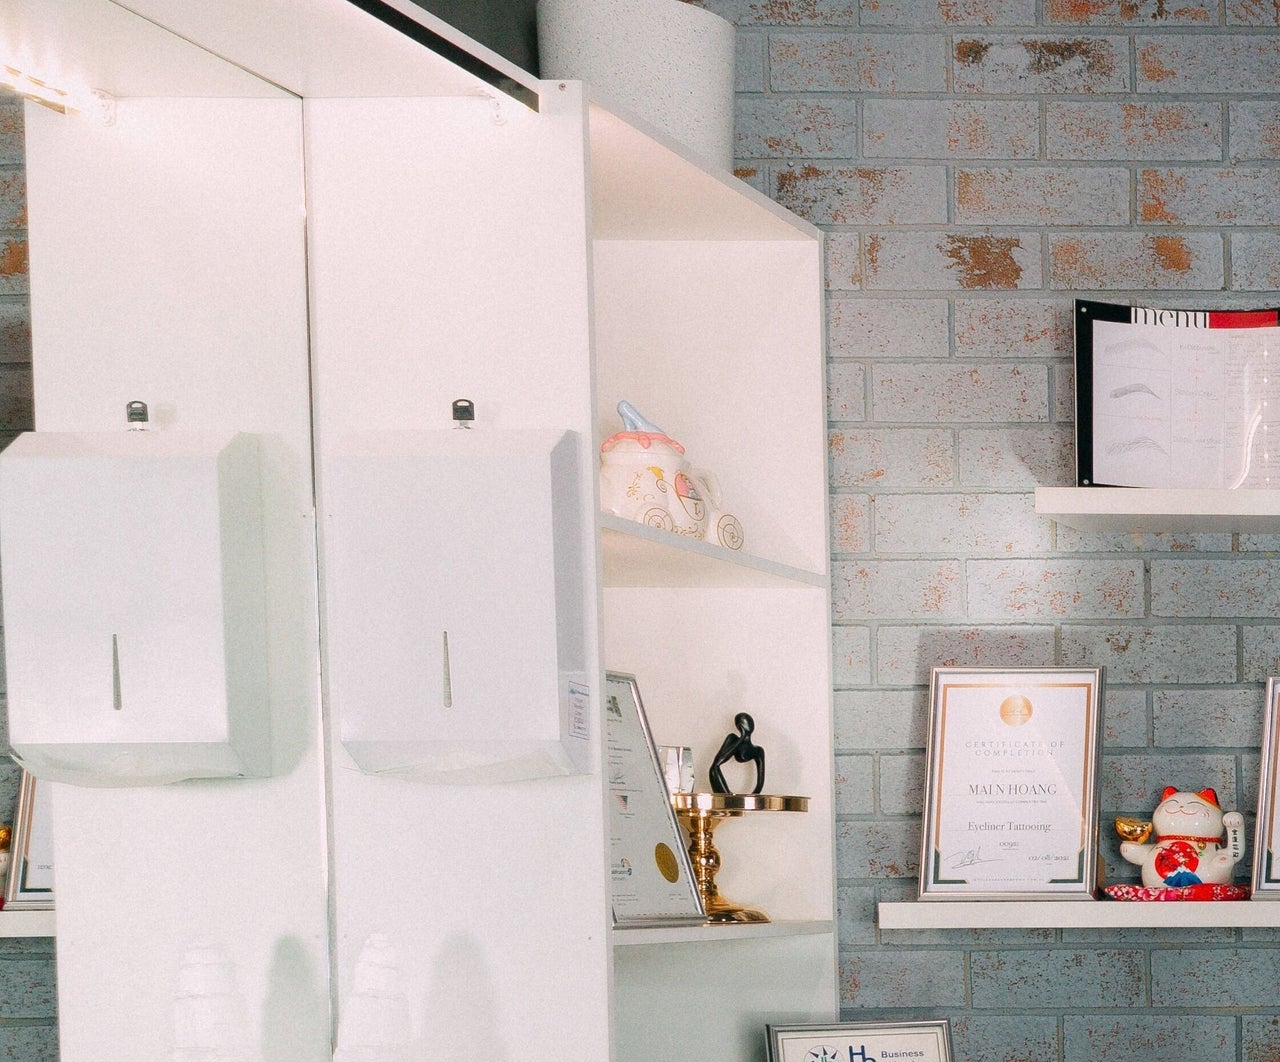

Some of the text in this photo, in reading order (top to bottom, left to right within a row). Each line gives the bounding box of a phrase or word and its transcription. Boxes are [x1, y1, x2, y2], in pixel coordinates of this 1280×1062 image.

[969, 784, 1057, 795] MAI N HOANG
[968, 821, 1052, 833] Eyeliner Tattooing
[881, 1050, 925, 1059] Business
